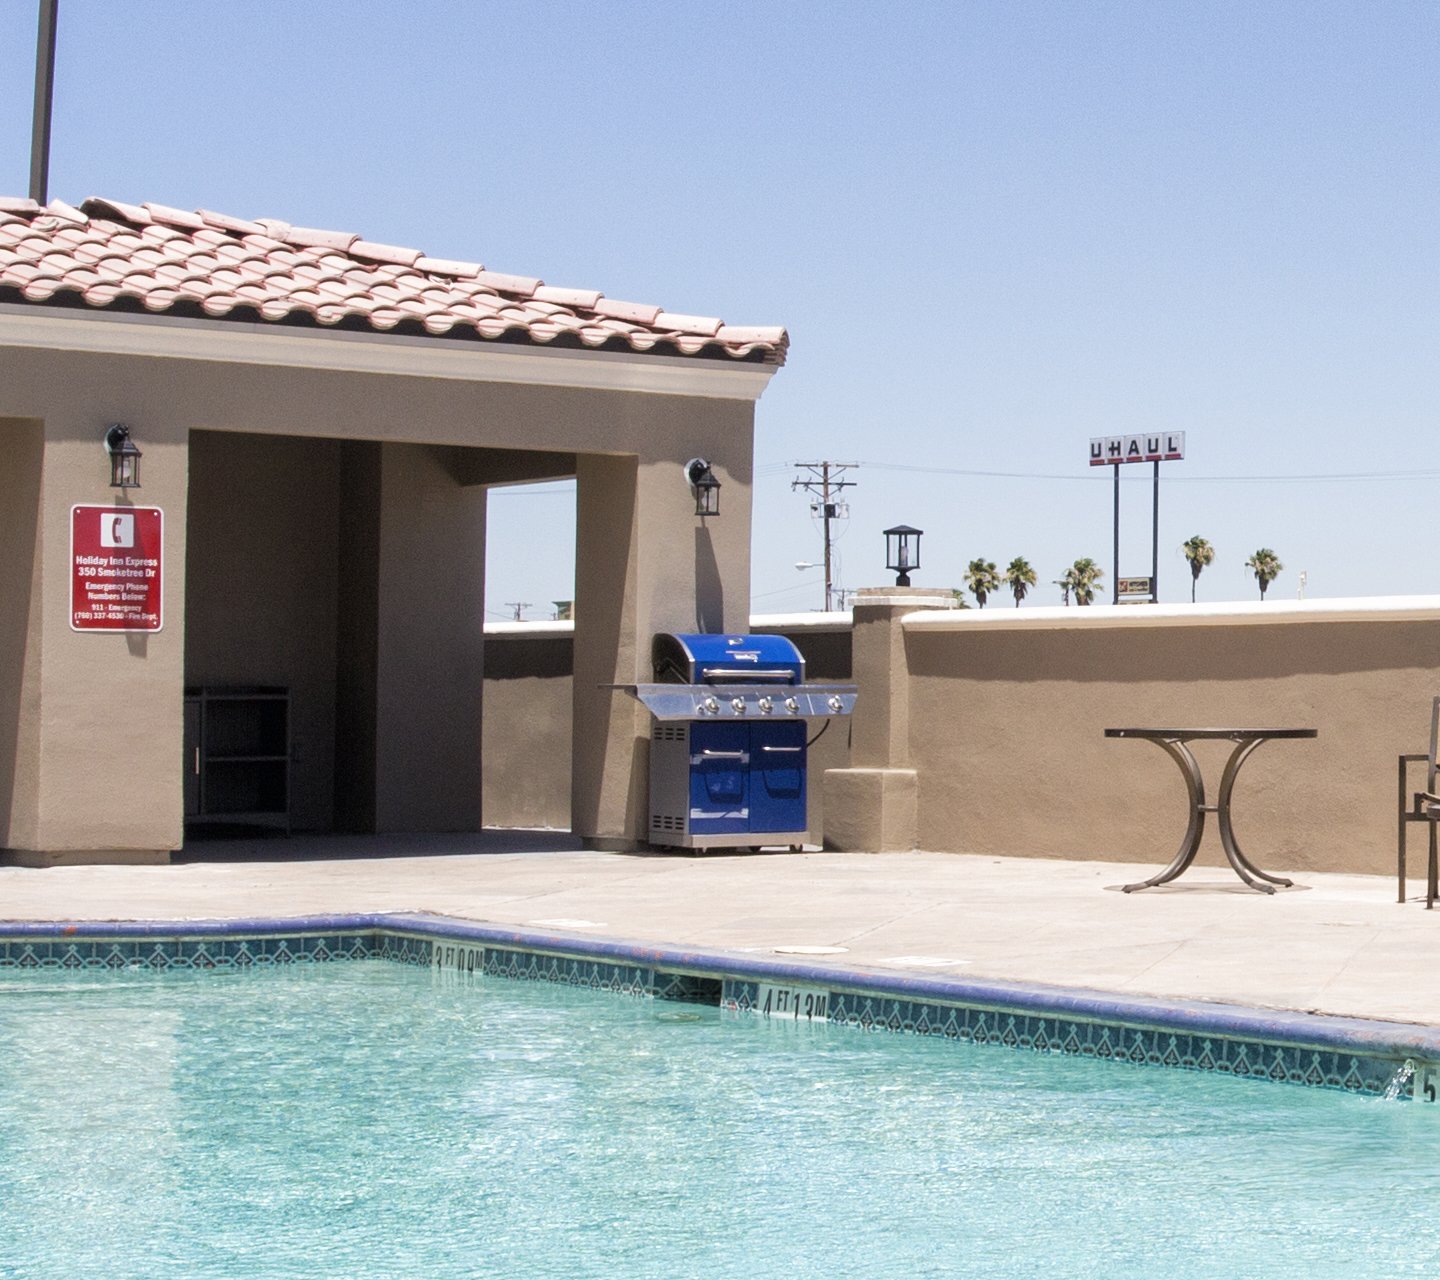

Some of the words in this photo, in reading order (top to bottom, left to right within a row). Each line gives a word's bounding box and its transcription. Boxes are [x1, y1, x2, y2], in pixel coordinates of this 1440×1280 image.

[76, 556, 108, 566] Holiday
[110, 556, 123, 565] Inn
[125, 557, 157, 567] Express
[78, 567, 96, 576] 350
[98, 568, 143, 576] Smoketree
[145, 569, 156, 577] Dr
[85, 582, 124, 591] Emergency
[446, 948, 455, 965] FT
[777, 990, 789, 1011] FT
[1423, 1068, 1436, 1103] 5
